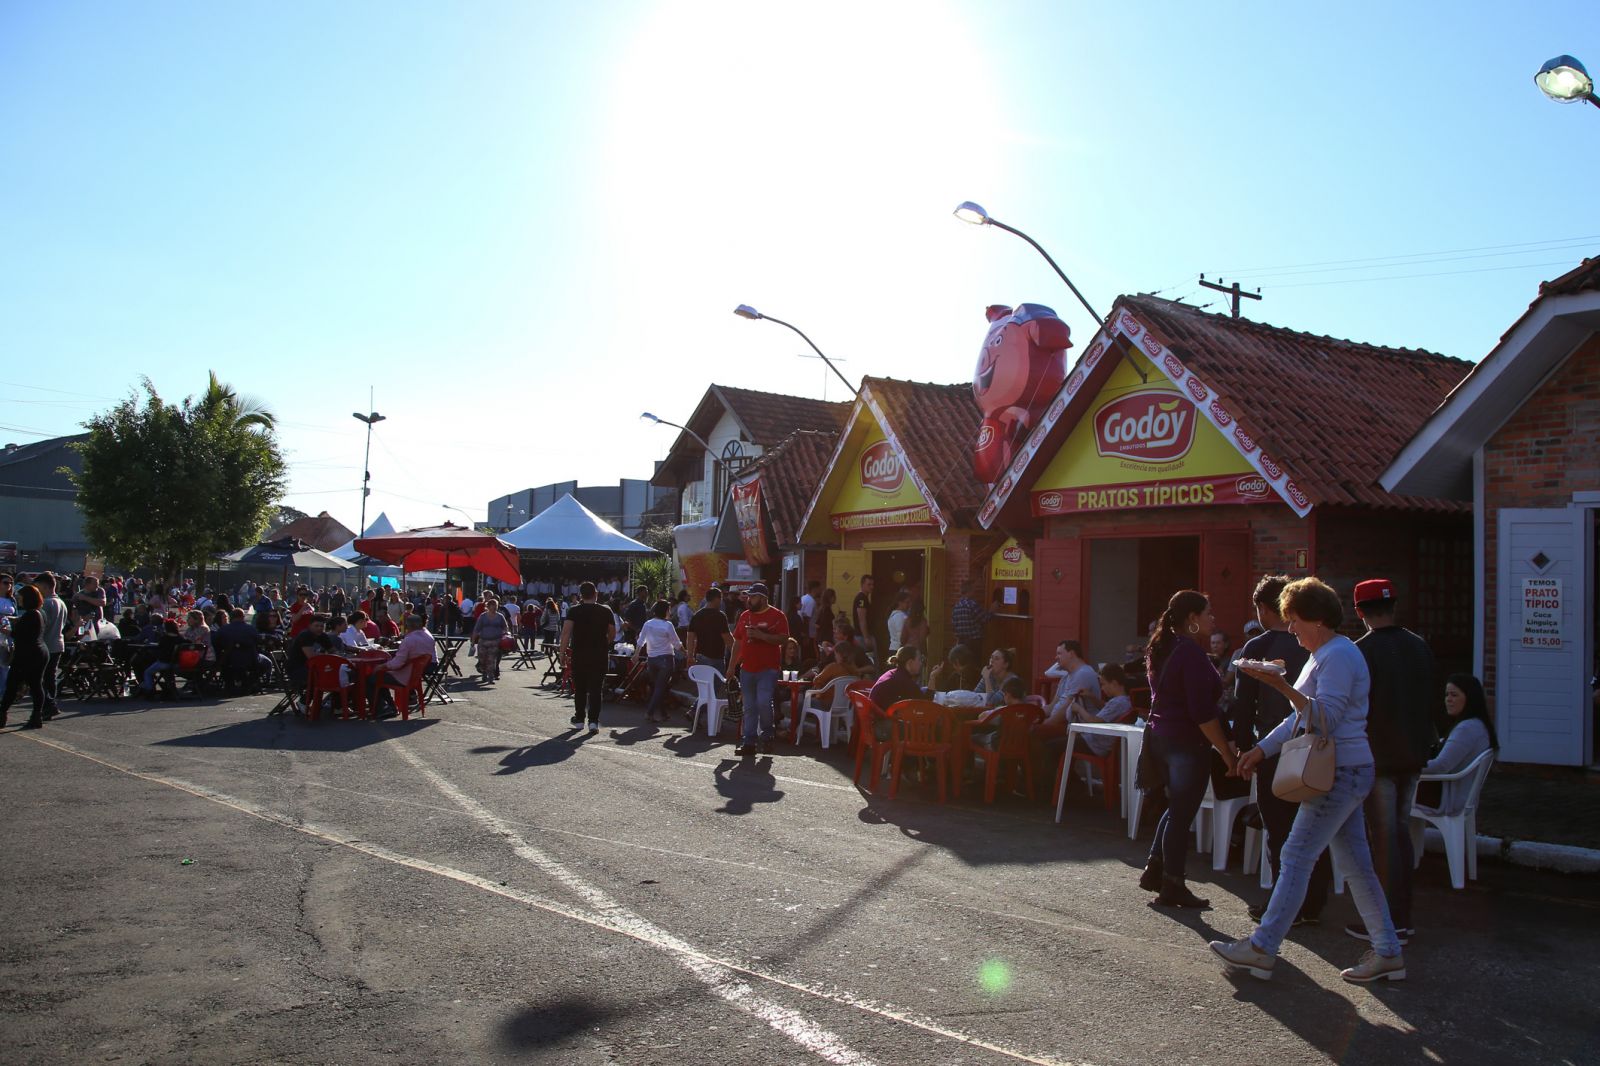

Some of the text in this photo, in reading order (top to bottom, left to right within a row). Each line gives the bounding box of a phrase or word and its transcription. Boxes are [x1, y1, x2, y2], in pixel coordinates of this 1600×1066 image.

[1143, 335, 1161, 355] Godoy
[1165, 356, 1184, 377] Godoy
[1188, 379, 1207, 399] Godoy
[1210, 402, 1231, 424] Godoy
[1103, 404, 1188, 449] Godoy
[1235, 428, 1256, 450] Godoy
[864, 451, 901, 481] Godoy
[1261, 454, 1281, 478] Godoy
[1041, 480, 1267, 509] Godoy PRATOS TÍPICOS Godoy
[1287, 482, 1308, 506] Godoy
[1525, 588, 1559, 597] PRATO
[1525, 627, 1559, 635] Mostarda
[1526, 619, 1558, 627] Linguiça
[1522, 636, 1561, 646] R$ 15,00
